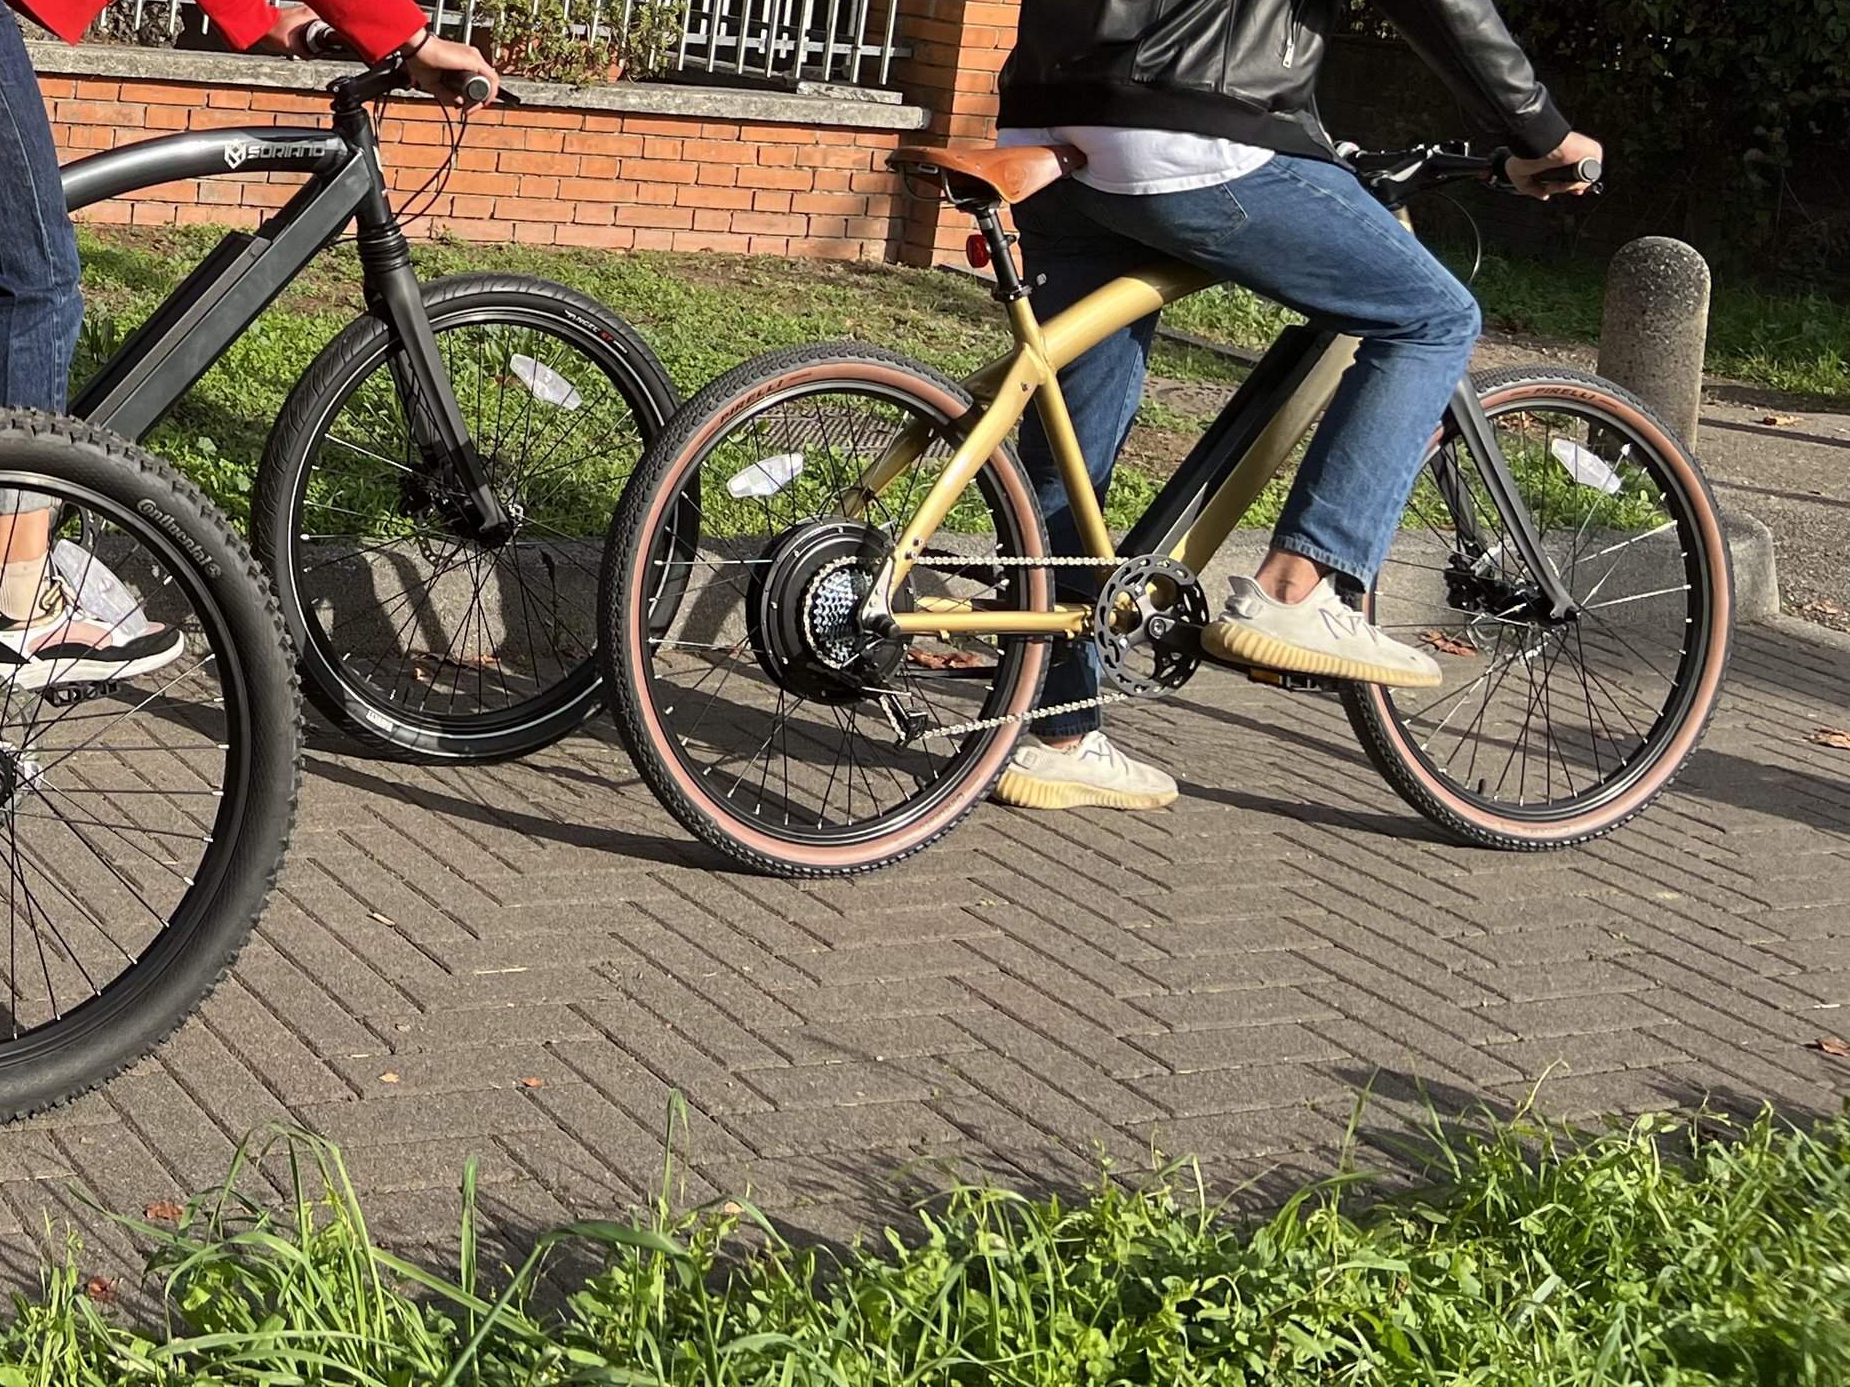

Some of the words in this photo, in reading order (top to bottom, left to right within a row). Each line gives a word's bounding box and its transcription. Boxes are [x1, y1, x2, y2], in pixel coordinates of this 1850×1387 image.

[246, 145, 326, 159] SORIANO
[1533, 387, 1596, 400] PIRELLI
[137, 498, 213, 565] Continental
